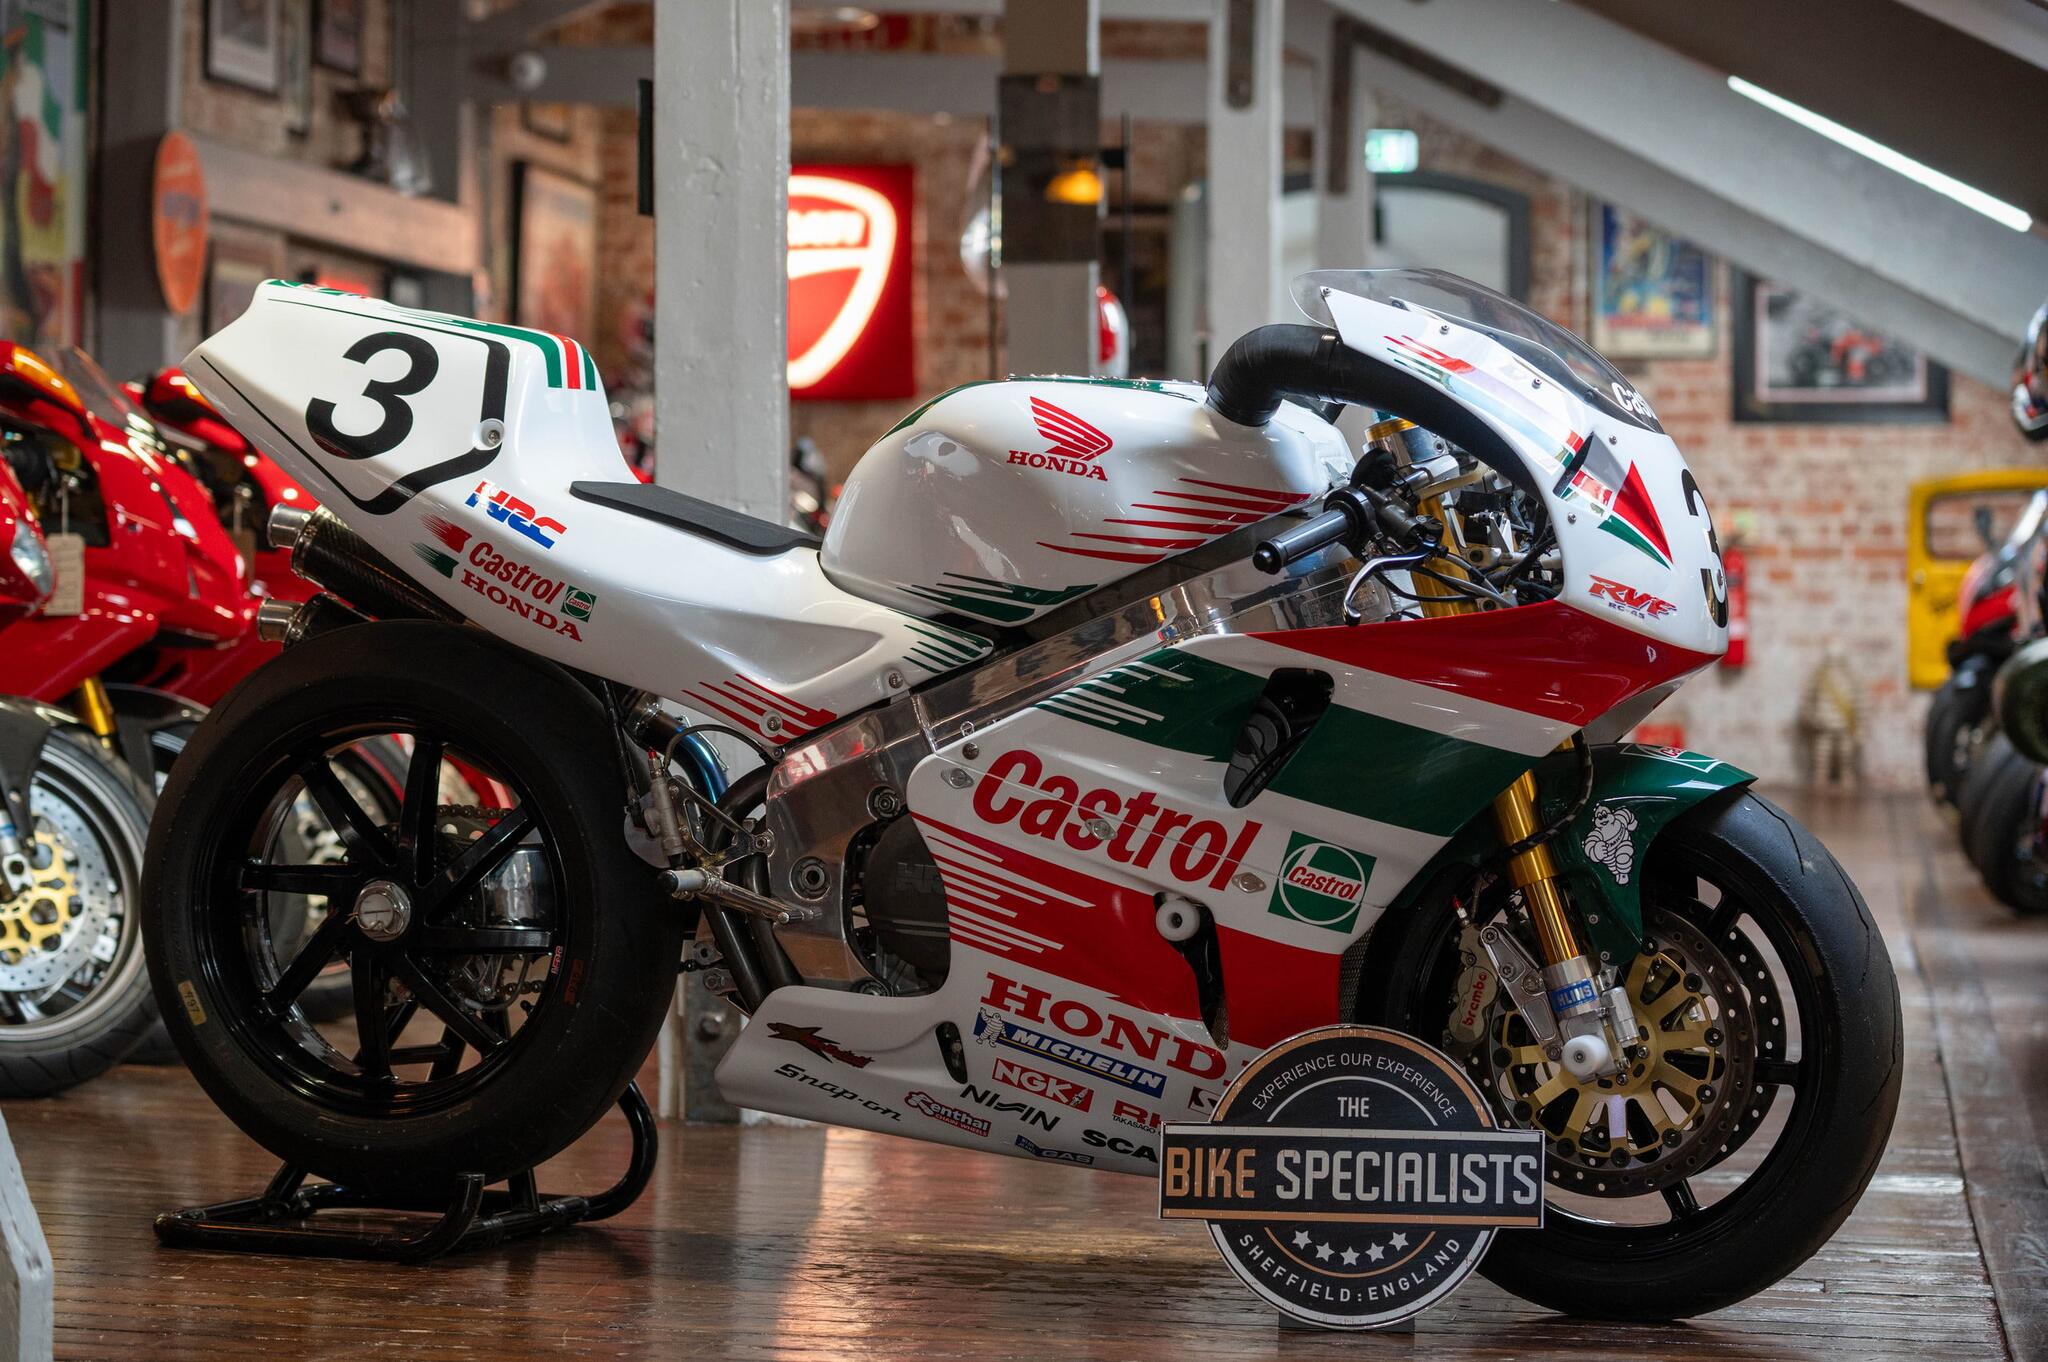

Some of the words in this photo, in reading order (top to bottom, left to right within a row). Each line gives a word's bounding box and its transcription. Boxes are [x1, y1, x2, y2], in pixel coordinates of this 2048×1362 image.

[305, 331, 439, 460] 3
[1006, 450, 1108, 481] HONDA
[469, 542, 565, 604] Castrol
[1681, 469, 1729, 628] 3
[461, 569, 582, 642] HONDA
[568, 597, 591, 610] Castrol
[1589, 574, 1677, 619] RVF
[972, 749, 1262, 891] Castrol
[1288, 865, 1361, 900] Castrol
[1462, 971, 1487, 1026] brembo
[980, 972, 1250, 1087] HOND
[996, 1059, 1073, 1104] NGK
[1010, 1027, 1164, 1089] MICHELIN
[1252, 1057, 1336, 1111] EXPERIENCE
[1340, 1053, 1371, 1067] OUR
[1377, 1057, 1458, 1119] EXPERIENCE
[774, 1063, 902, 1121] Snap-on
[906, 1092, 989, 1131] Renthal
[1338, 1096, 1369, 1118] THE
[1111, 1114, 1155, 1134] TAKASAGO
[1041, 1148, 1092, 1164] GAS
[1165, 1147, 1256, 1198] BIKE
[1276, 1149, 1538, 1205] SPECIALISTS
